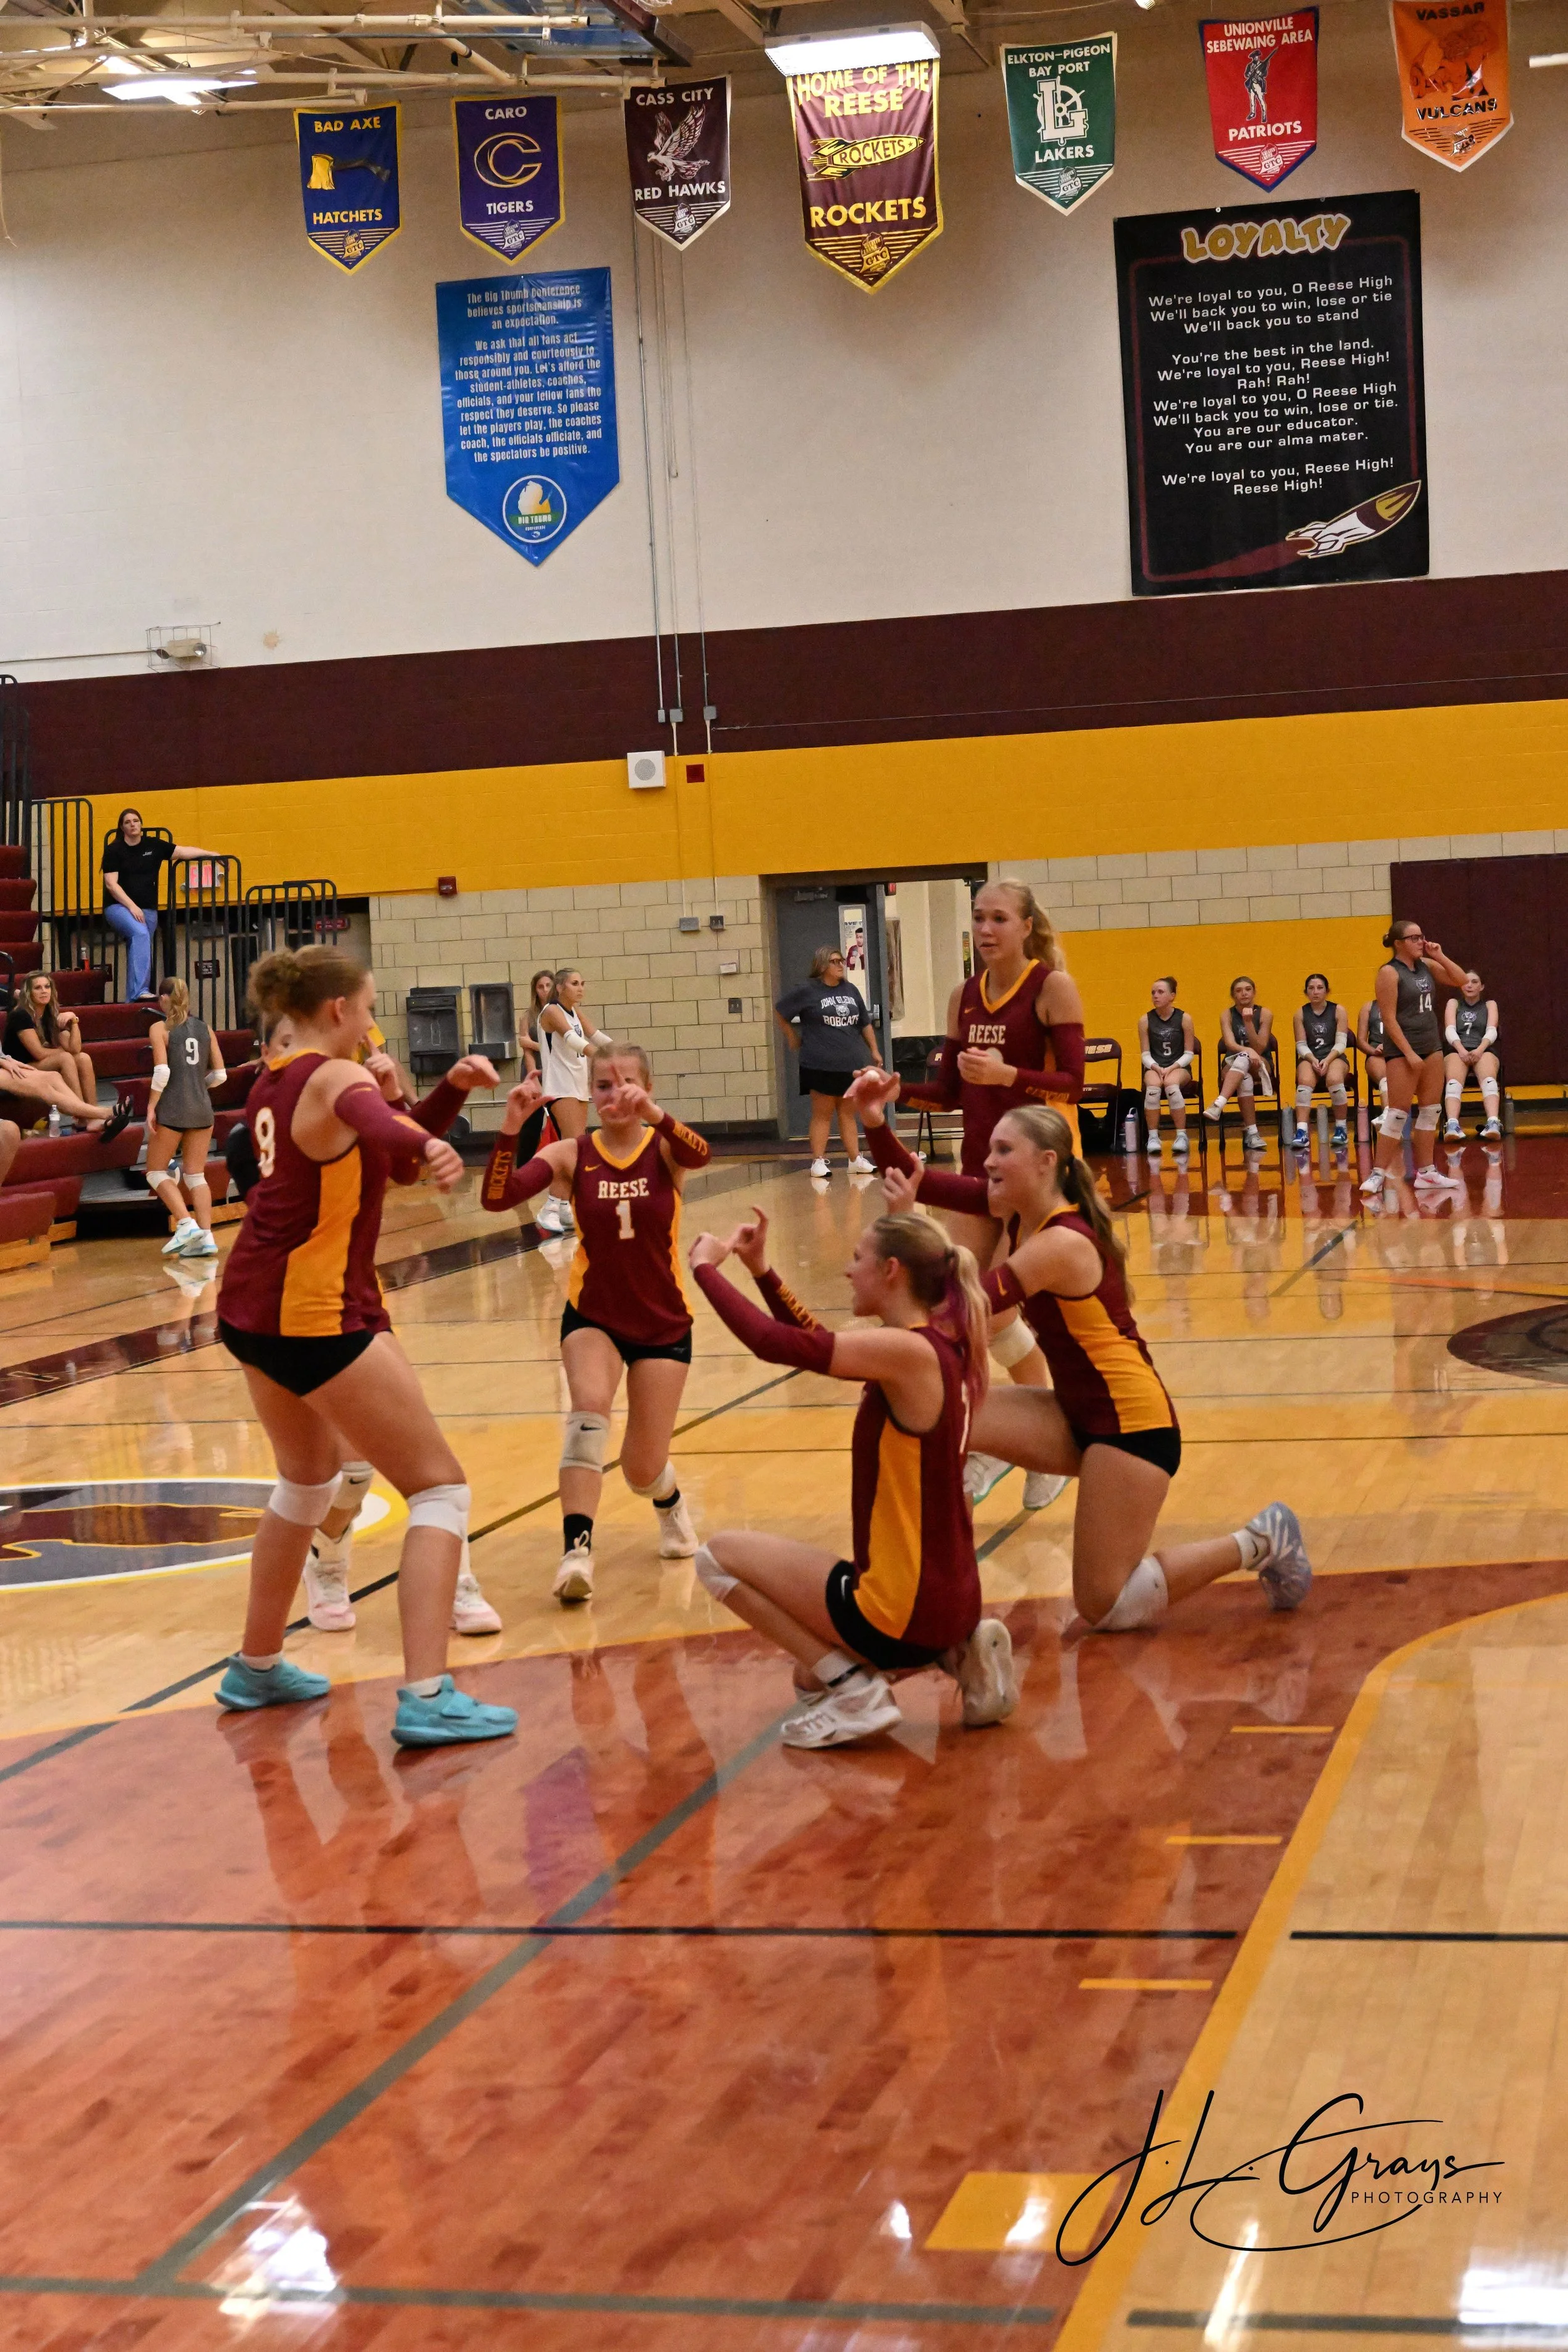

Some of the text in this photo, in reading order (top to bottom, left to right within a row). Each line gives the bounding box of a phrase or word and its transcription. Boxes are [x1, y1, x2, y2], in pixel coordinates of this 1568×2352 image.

[1416, 2, 1485, 21] VASSAR
[1224, 16, 1293, 37] UNIONVILLE
[1207, 29, 1313, 53] SEBEWAING AREA
[1007, 43, 1111, 65] ELKTON-PIGEON
[1029, 61, 1090, 78] BAY PORT
[797, 61, 930, 105] HOME OF THE
[636, 87, 714, 106] CASS CITY
[824, 88, 903, 118] REESE
[485, 106, 527, 120] CARO
[1416, 98, 1498, 120] VULCANS
[314, 116, 381, 133] BAD AXE
[1228, 120, 1302, 141] PATRIOTS
[839, 139, 906, 164] ROCKETS
[1035, 144, 1094, 163] LAKERS
[1264, 157, 1281, 169] GTC
[634, 181, 726, 201] RED HAWKS
[1062, 180, 1079, 192] GTC
[313, 209, 383, 225] HATCHETS
[486, 200, 534, 215] TIGERS
[810, 196, 926, 228] ROCKETS
[677, 217, 694, 228] GTC
[507, 233, 523, 244] GTC
[1181, 214, 1351, 263] LOYALTY
[866, 251, 887, 266] GTC
[1148, 275, 1392, 307] We're loyal to you, O Reese High
[1150, 291, 1392, 322] We'll back you to win, lose or tie
[1184, 308, 1359, 334] We'll back you to stand
[1172, 337, 1374, 365] You're the best in the land.
[455, 368, 479, 381] those
[482, 366, 511, 378] around
[514, 365, 532, 377] you.
[535, 362, 555, 374] Let's
[586, 358, 600, 369] the
[1157, 351, 1389, 382] We're loyal to you, Reese High!
[470, 373, 586, 393] student-athletes, coaches,
[1237, 373, 1310, 390] Rah! Rah!
[497, 393, 511, 405] and
[514, 393, 534, 405] your
[586, 385, 601, 397] the
[1153, 381, 1396, 412] We're loyal to you, O Reese High
[461, 400, 598, 423] respect they deserve. So please
[1153, 396, 1398, 427] We'll back you to win, lose or tie.
[460, 413, 601, 435] let the players play, the coaches
[1194, 417, 1358, 438] You are our educator.
[461, 437, 489, 451] coach,
[492, 435, 506, 447] the
[586, 427, 601, 438] and
[1185, 432, 1368, 454] You are our alma mater.
[474, 442, 590, 462] the spectators be positive.
[1162, 457, 1394, 486] We're loyal to you, Reese High!
[1234, 477, 1322, 495] Reese High!
[1418, 993, 1432, 1013] 14
[968, 1024, 1006, 1044] REESE
[1464, 1022, 1473, 1035] 7
[185, 1037, 199, 1065] 9
[1162, 1042, 1172, 1056] 5
[1315, 1037, 1325, 1049] 2
[598, 1177, 650, 1199] REESE
[616, 1200, 635, 1240] 1
